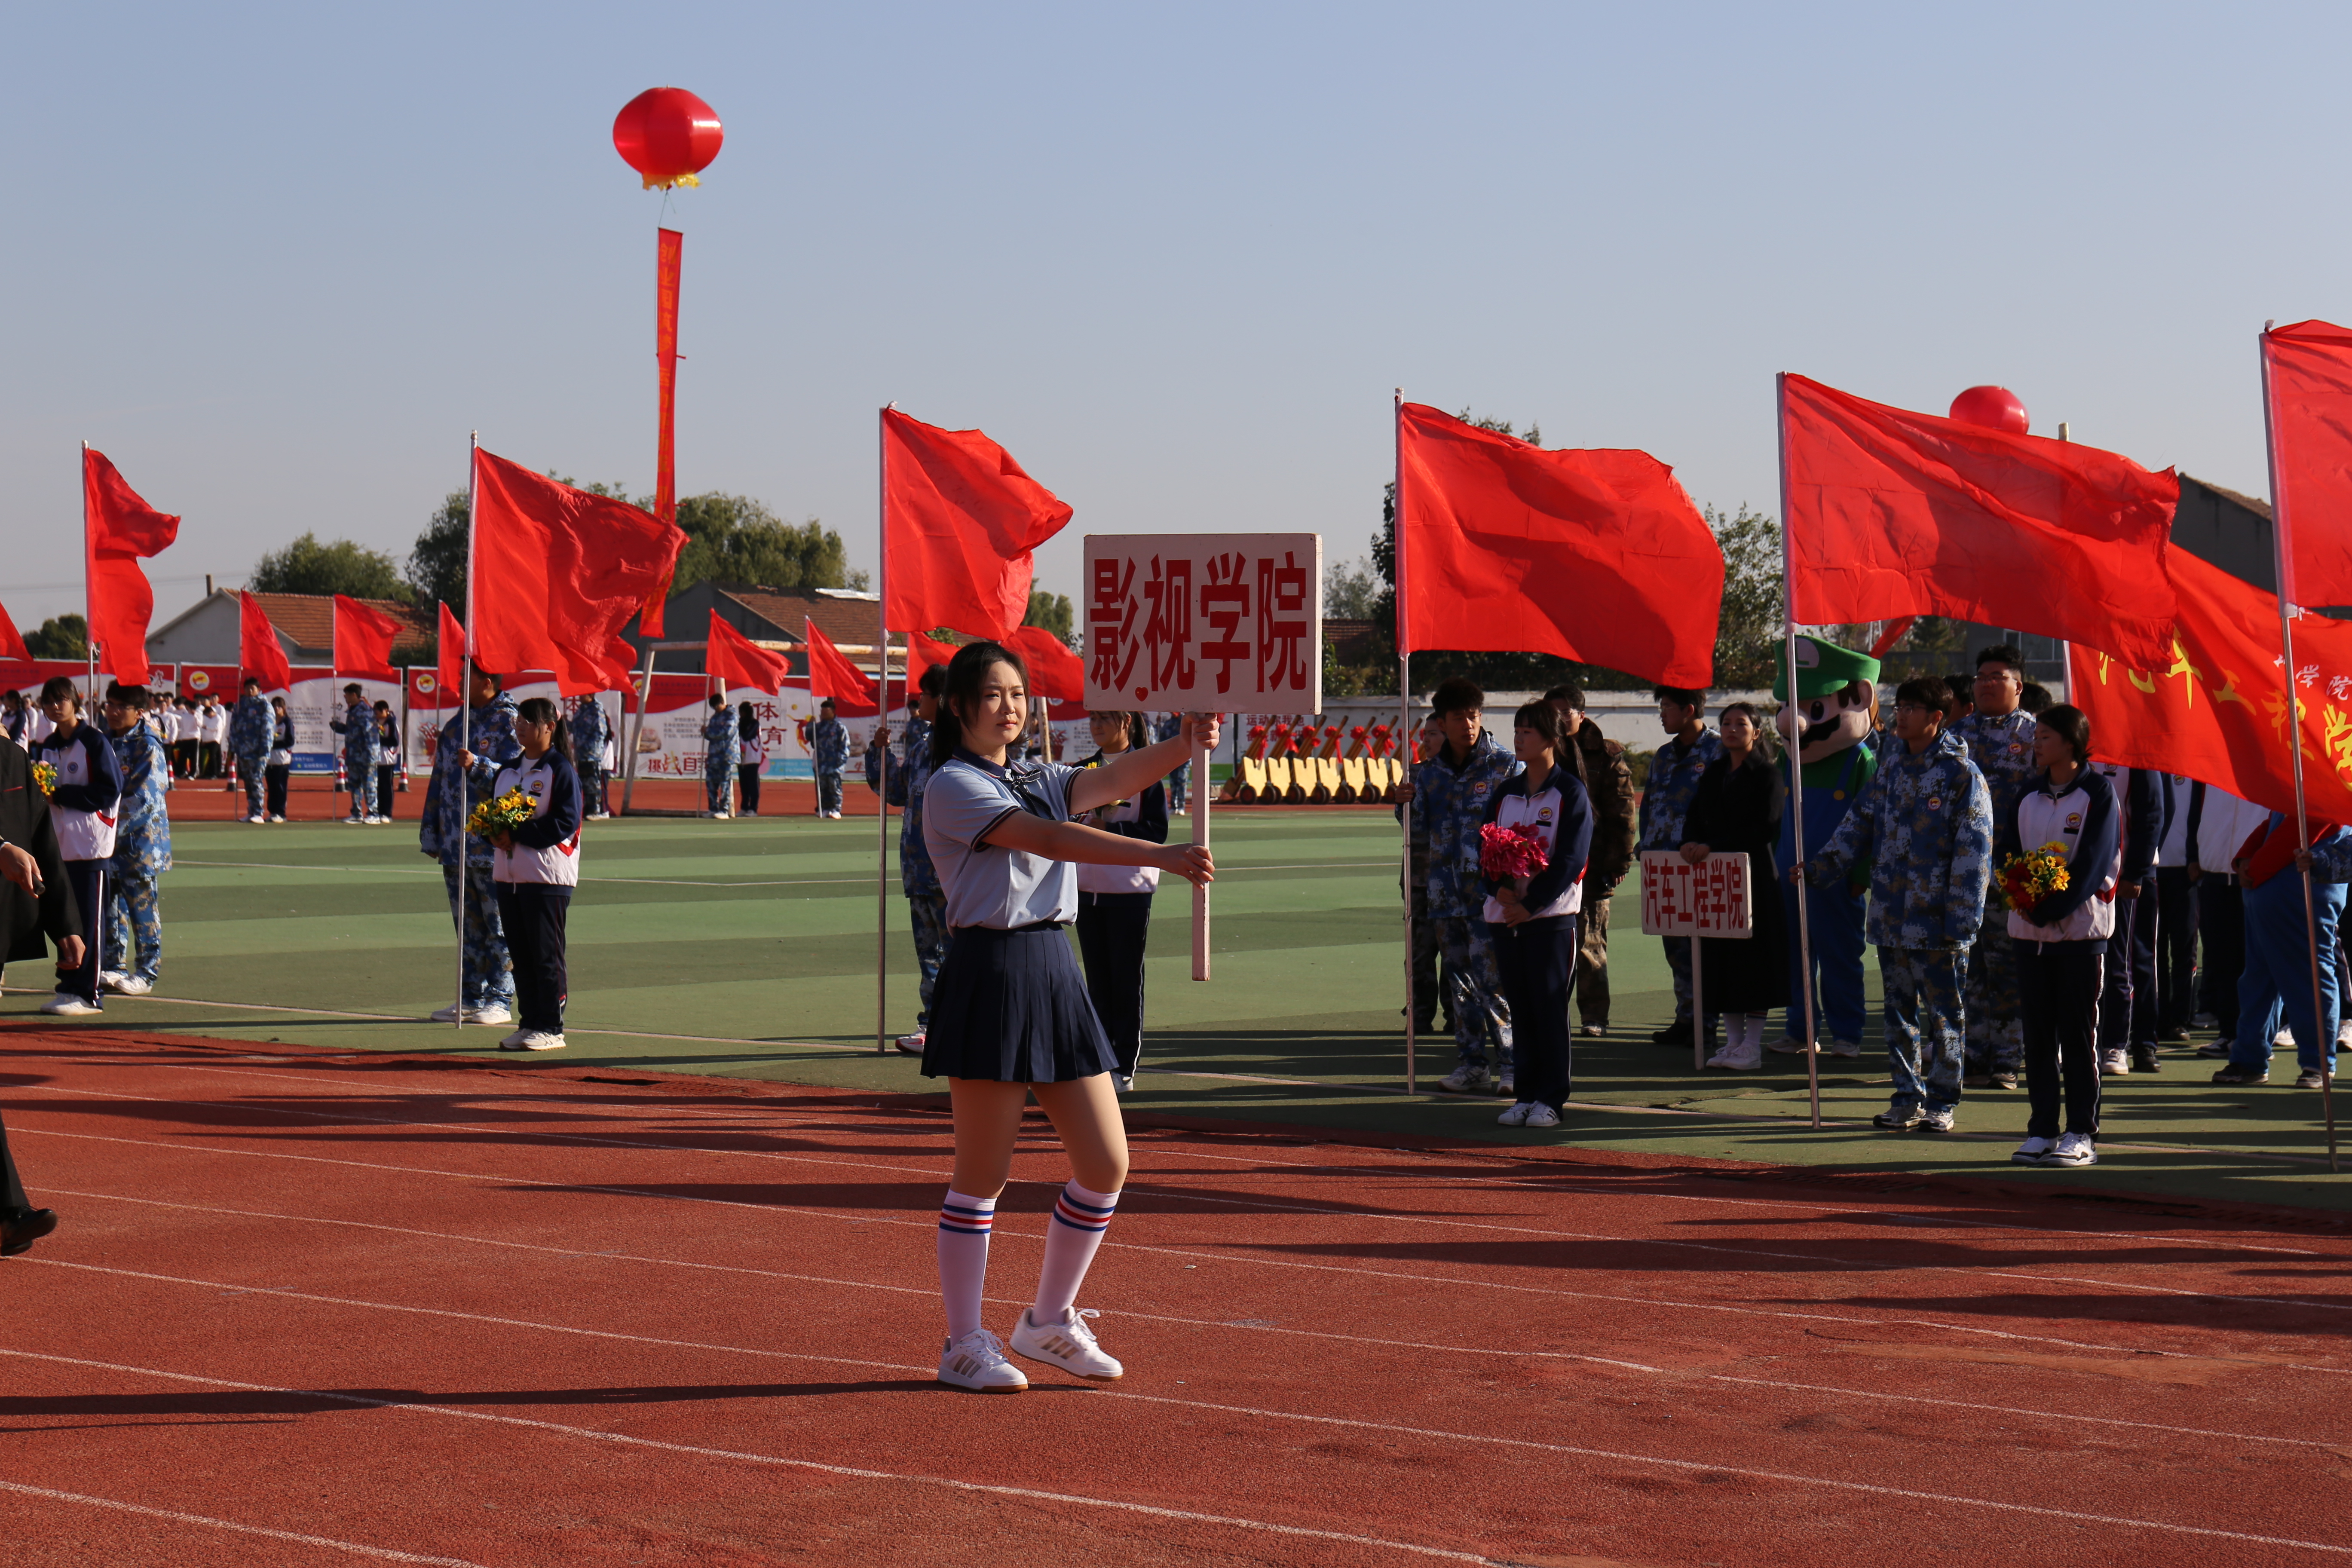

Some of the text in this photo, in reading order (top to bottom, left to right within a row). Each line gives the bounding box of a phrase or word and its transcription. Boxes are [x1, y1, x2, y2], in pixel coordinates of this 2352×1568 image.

[1090, 551, 1307, 694] 影视学院
[2273, 654, 2352, 701] 学院
[1644, 858, 1744, 931] 汽车工程学院
